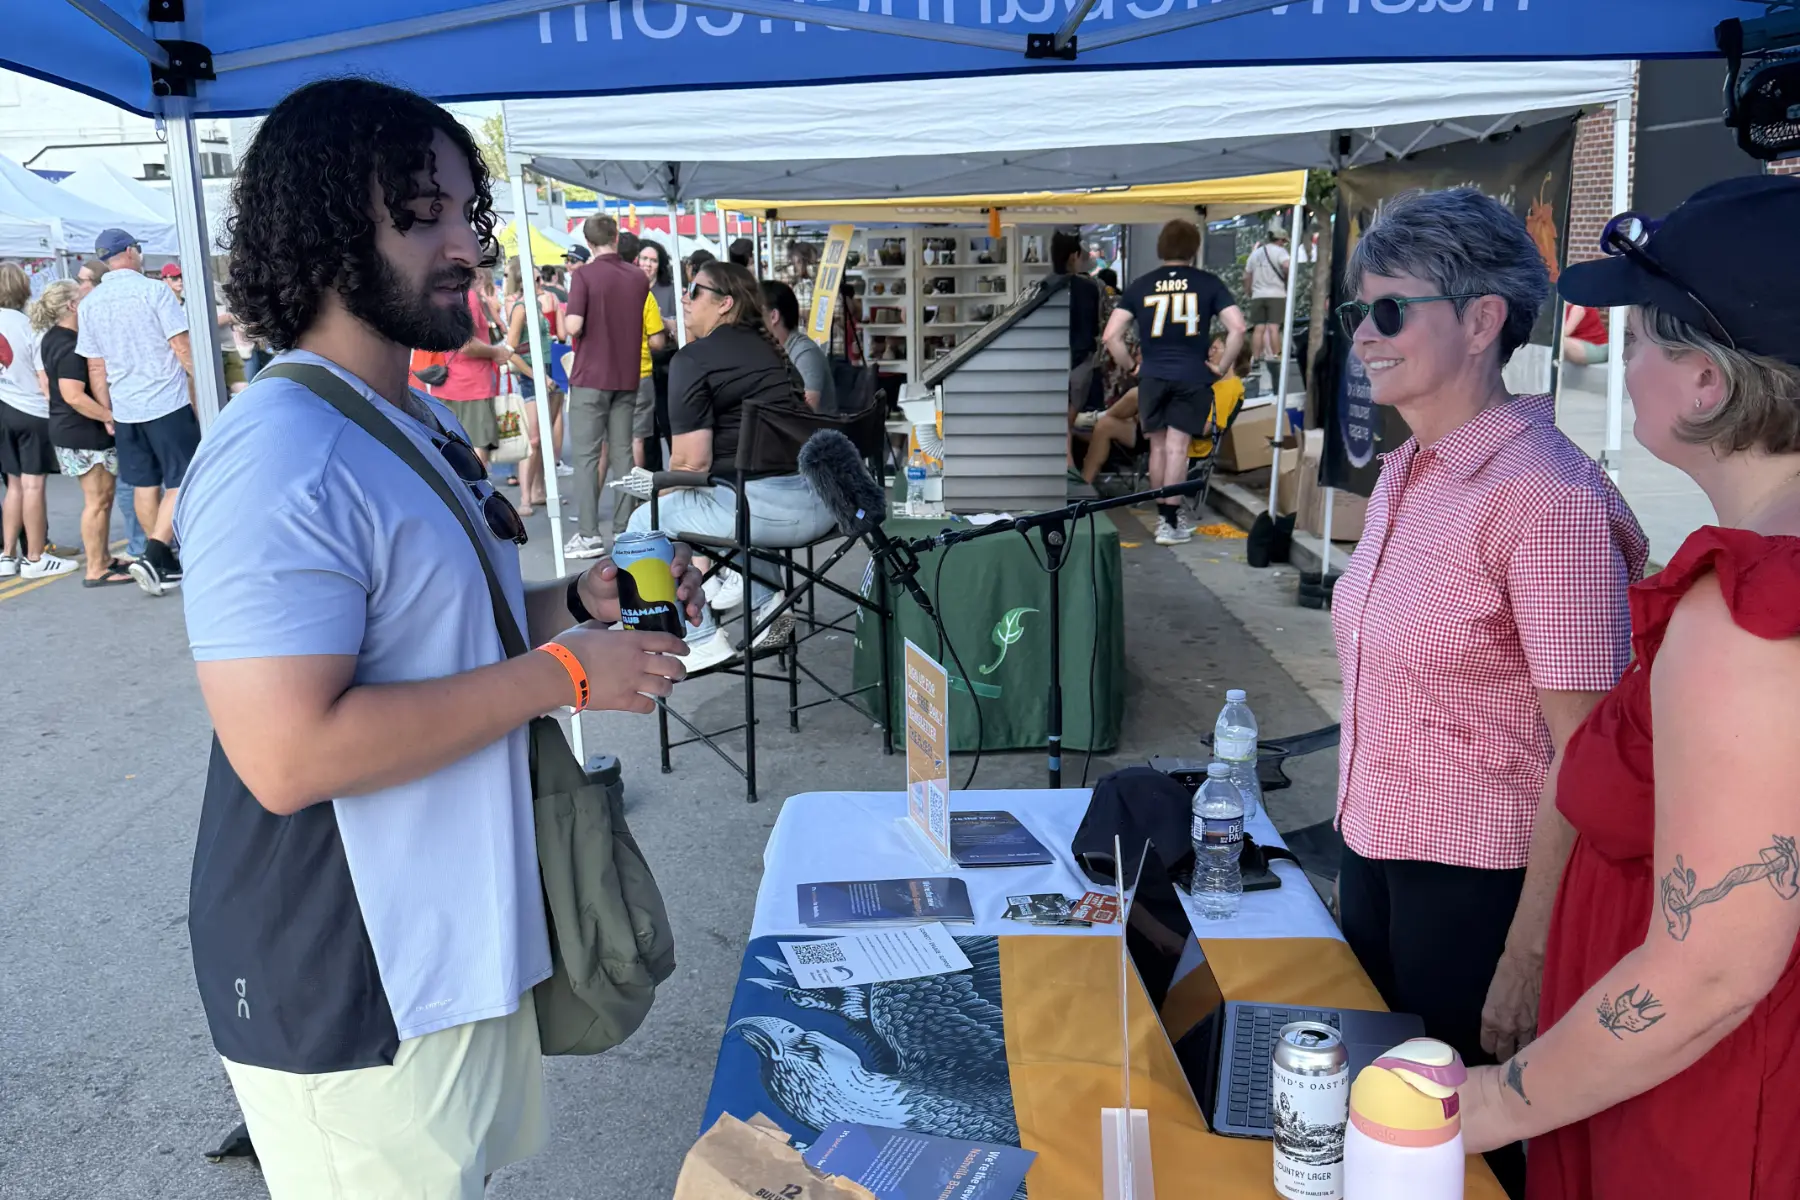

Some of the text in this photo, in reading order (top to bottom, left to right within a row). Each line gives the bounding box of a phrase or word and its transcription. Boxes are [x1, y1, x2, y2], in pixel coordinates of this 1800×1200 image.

[1155, 279, 1188, 292] SAROS
[1143, 292, 1200, 338] 74
[1309, 1081, 1339, 1091] OAST
[937, 1148, 982, 1200] Nashville Bann
[959, 1151, 1001, 1200] We're the new
[1276, 1160, 1306, 1179] COUNTRY
[1307, 1172, 1332, 1181] LAGER
[779, 1183, 803, 1200] 12
